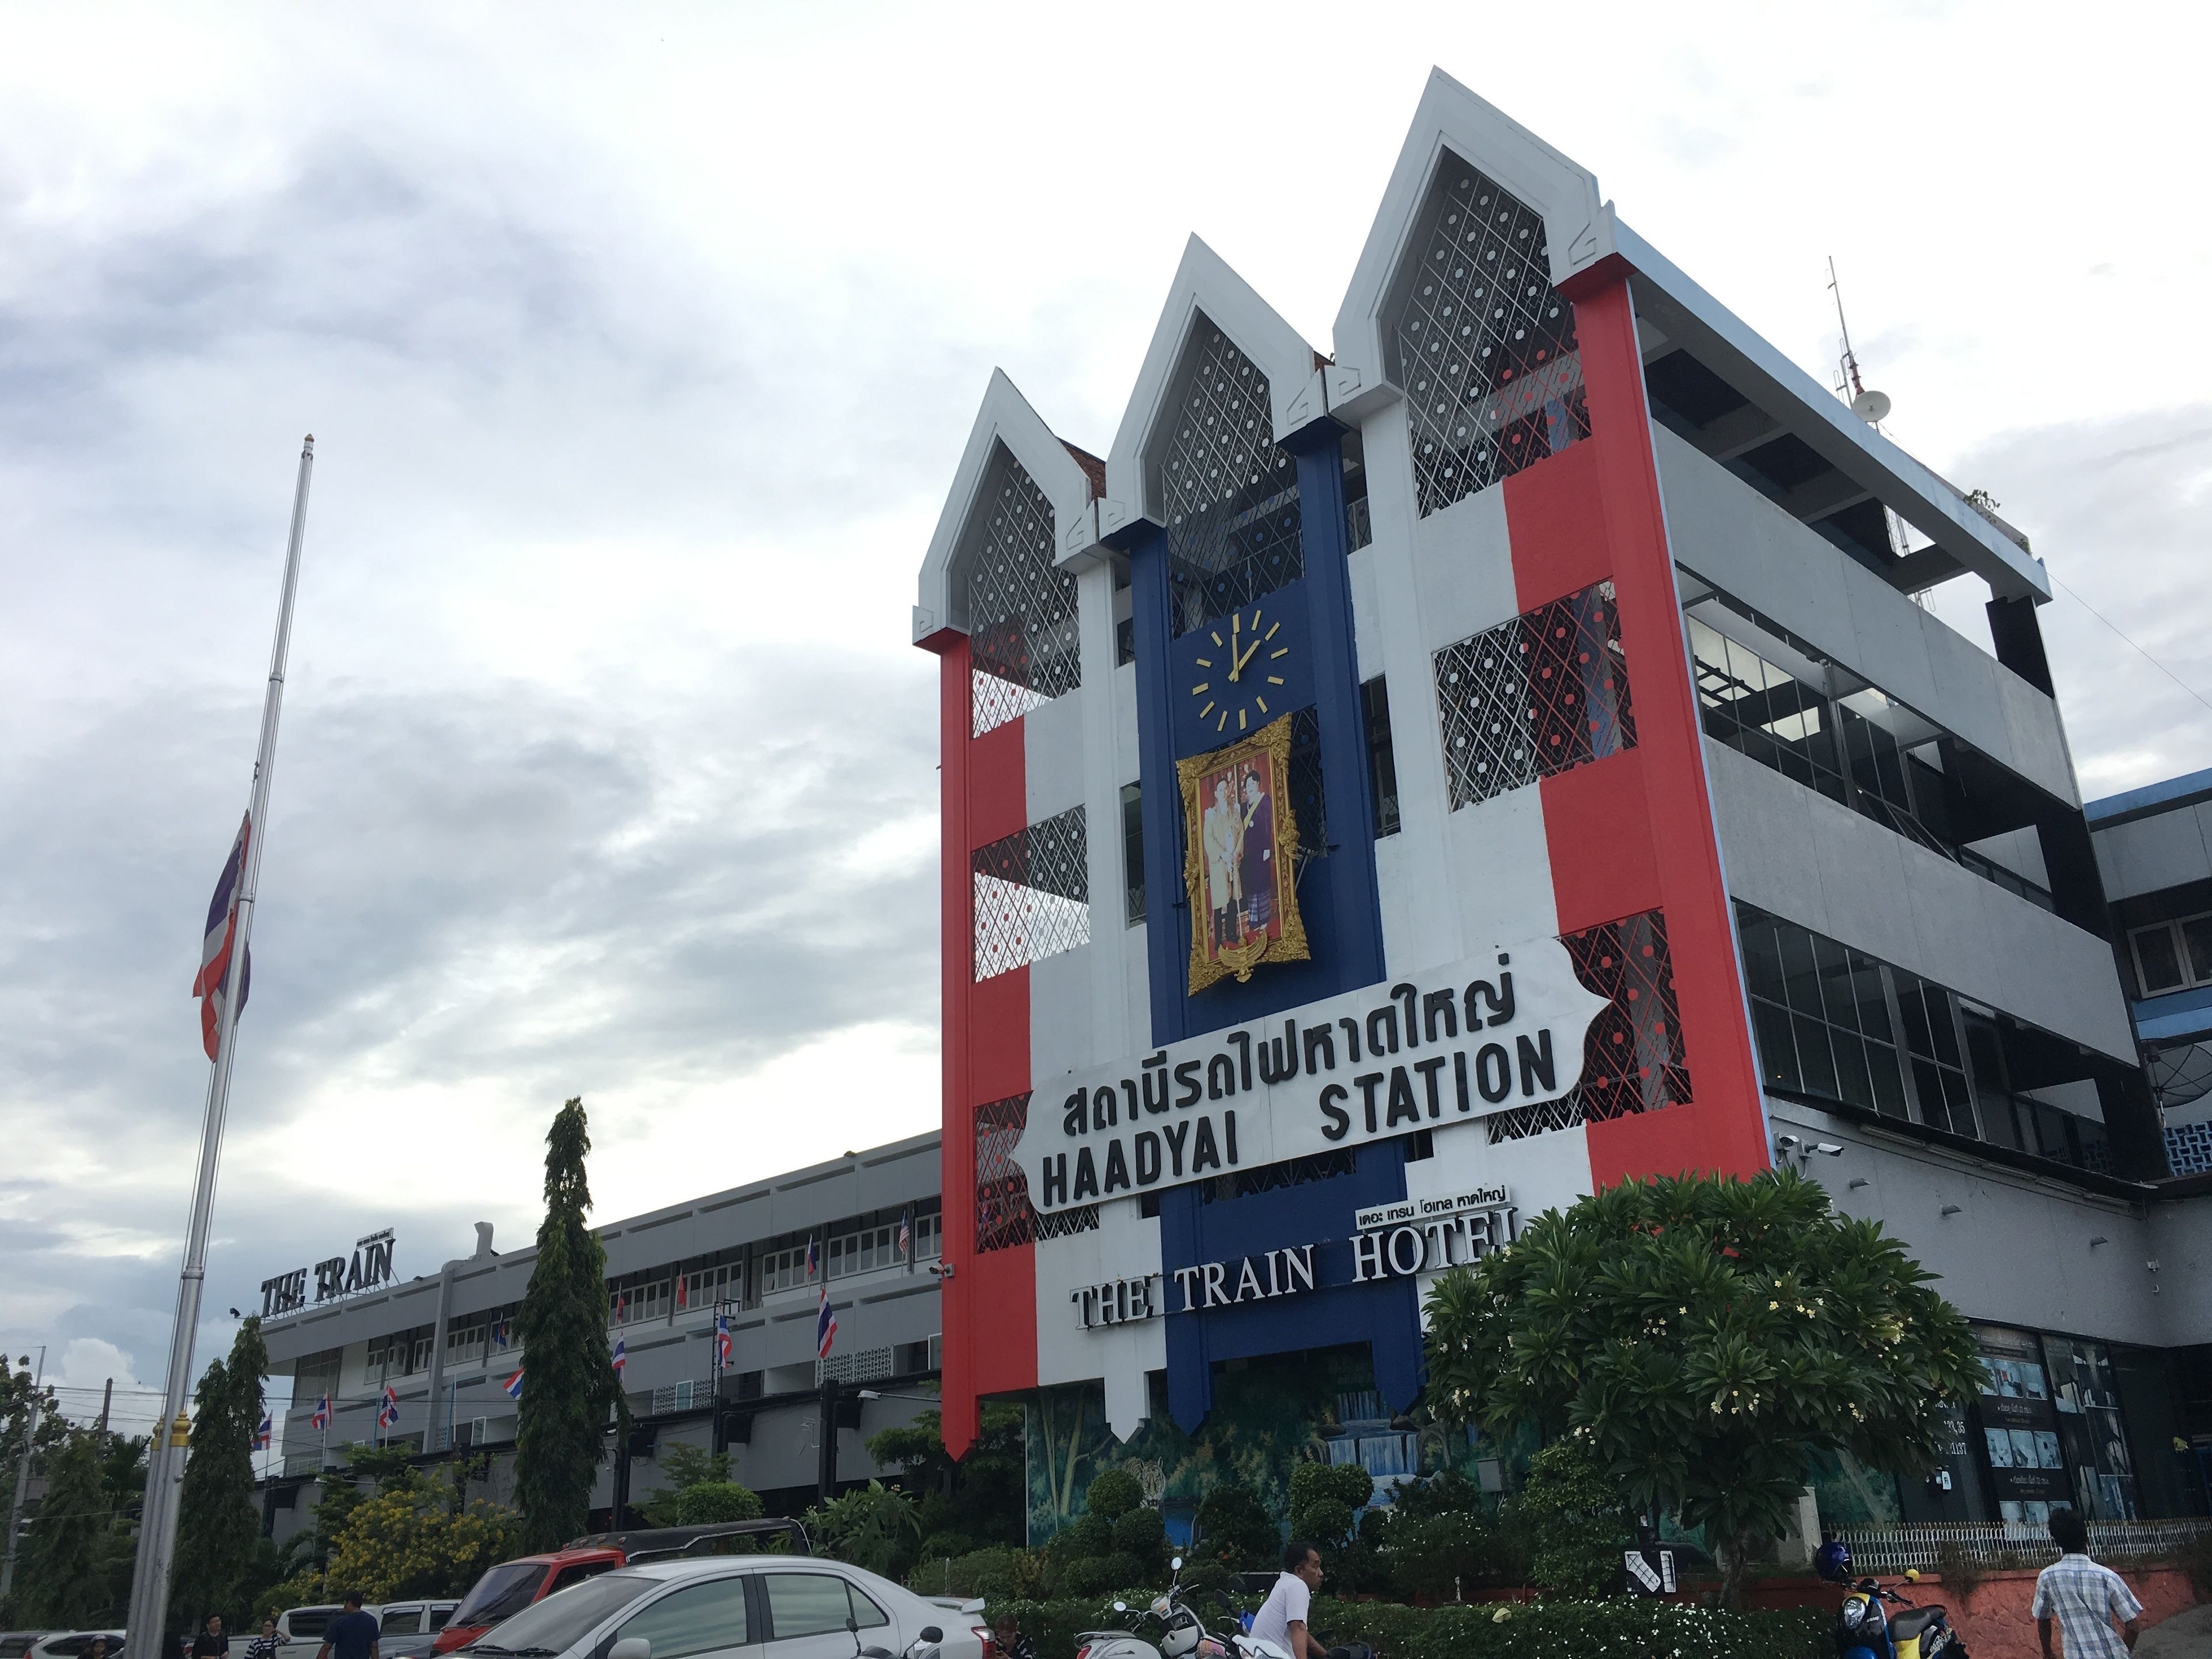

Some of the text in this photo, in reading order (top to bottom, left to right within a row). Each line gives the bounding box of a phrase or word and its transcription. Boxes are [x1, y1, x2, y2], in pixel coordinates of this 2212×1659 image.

[1063, 952, 1516, 1137] สถานีรถไฟหาดใหญ่
[1043, 1028, 1556, 1207] HAADYAI STATION
[1359, 1211, 1383, 1226] เดอะ
[1387, 1205, 1415, 1221] เทรน
[1457, 1184, 1506, 1207] หาดใหญ่
[260, 1238, 396, 1318] THE TRAIN
[1070, 1275, 1153, 1331] THE
[1174, 1244, 1316, 1312] TRAIN
